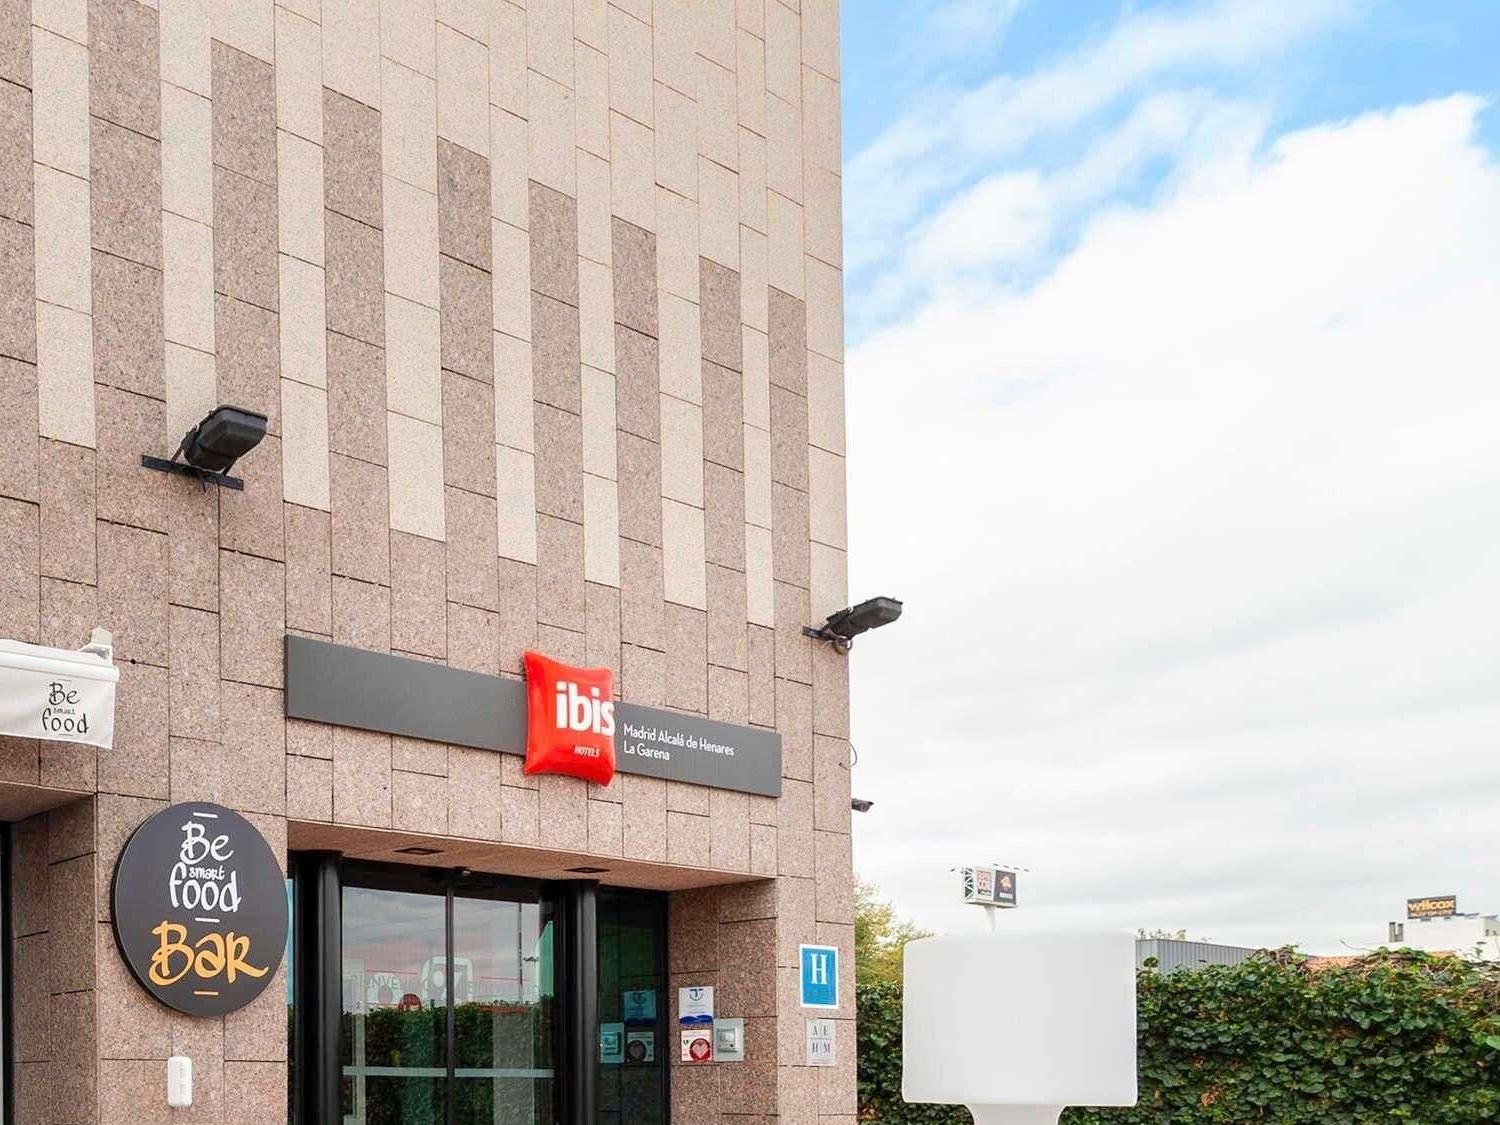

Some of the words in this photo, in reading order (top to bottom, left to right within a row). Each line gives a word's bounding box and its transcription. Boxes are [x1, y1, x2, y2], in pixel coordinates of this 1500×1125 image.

[49, 681, 81, 706] Be
[556, 681, 616, 737] ibis
[41, 707, 90, 734] food
[623, 722, 656, 741] Madrid
[658, 729, 684, 747] Alcalá
[686, 735, 697, 749] de
[699, 737, 735, 756] Henares
[623, 740, 635, 754] La
[637, 742, 670, 760] Garena
[180, 821, 234, 865] Be
[169, 861, 242, 912] food
[189, 865, 225, 880] smart
[810, 953, 828, 985] H
